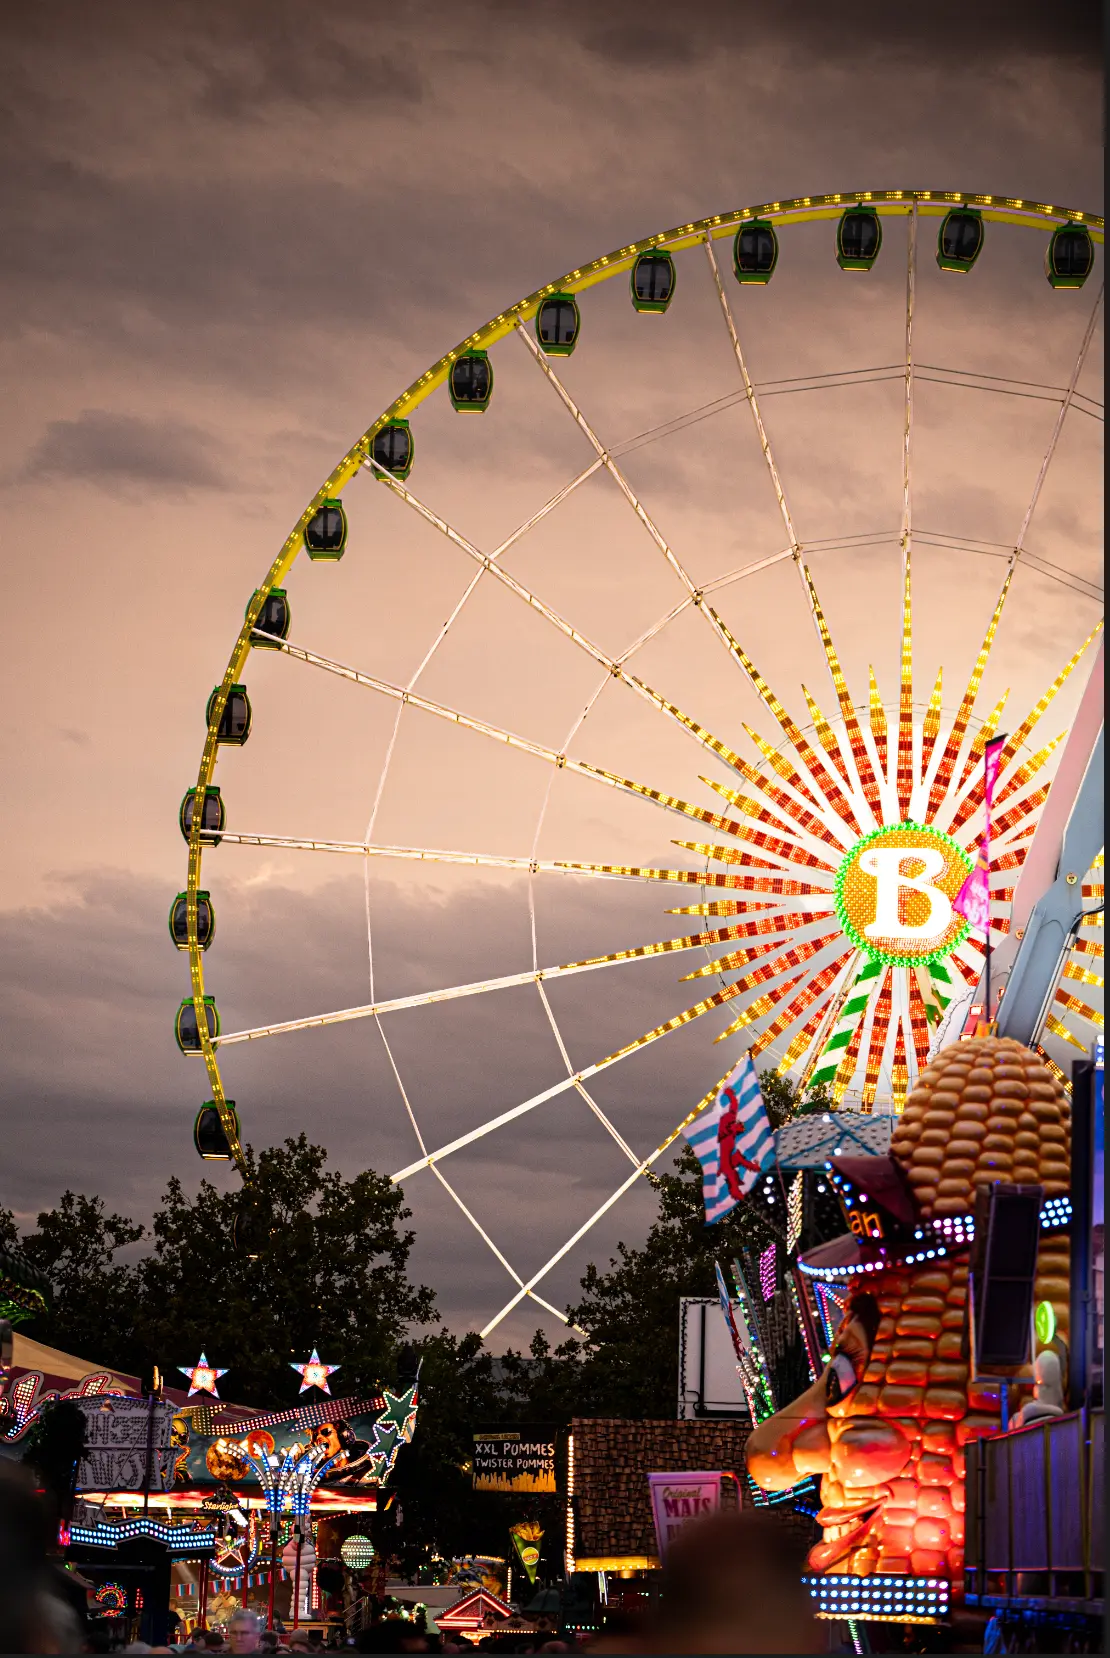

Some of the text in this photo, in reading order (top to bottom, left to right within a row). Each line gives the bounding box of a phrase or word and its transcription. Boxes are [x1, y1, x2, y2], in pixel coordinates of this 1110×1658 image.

[858, 847, 953, 939] B
[474, 1442, 556, 1457] XXL POMMES
[474, 1458, 555, 1470] TWISTER POMMES
[663, 1486, 703, 1499] Original
[663, 1498, 711, 1518] MAIS
